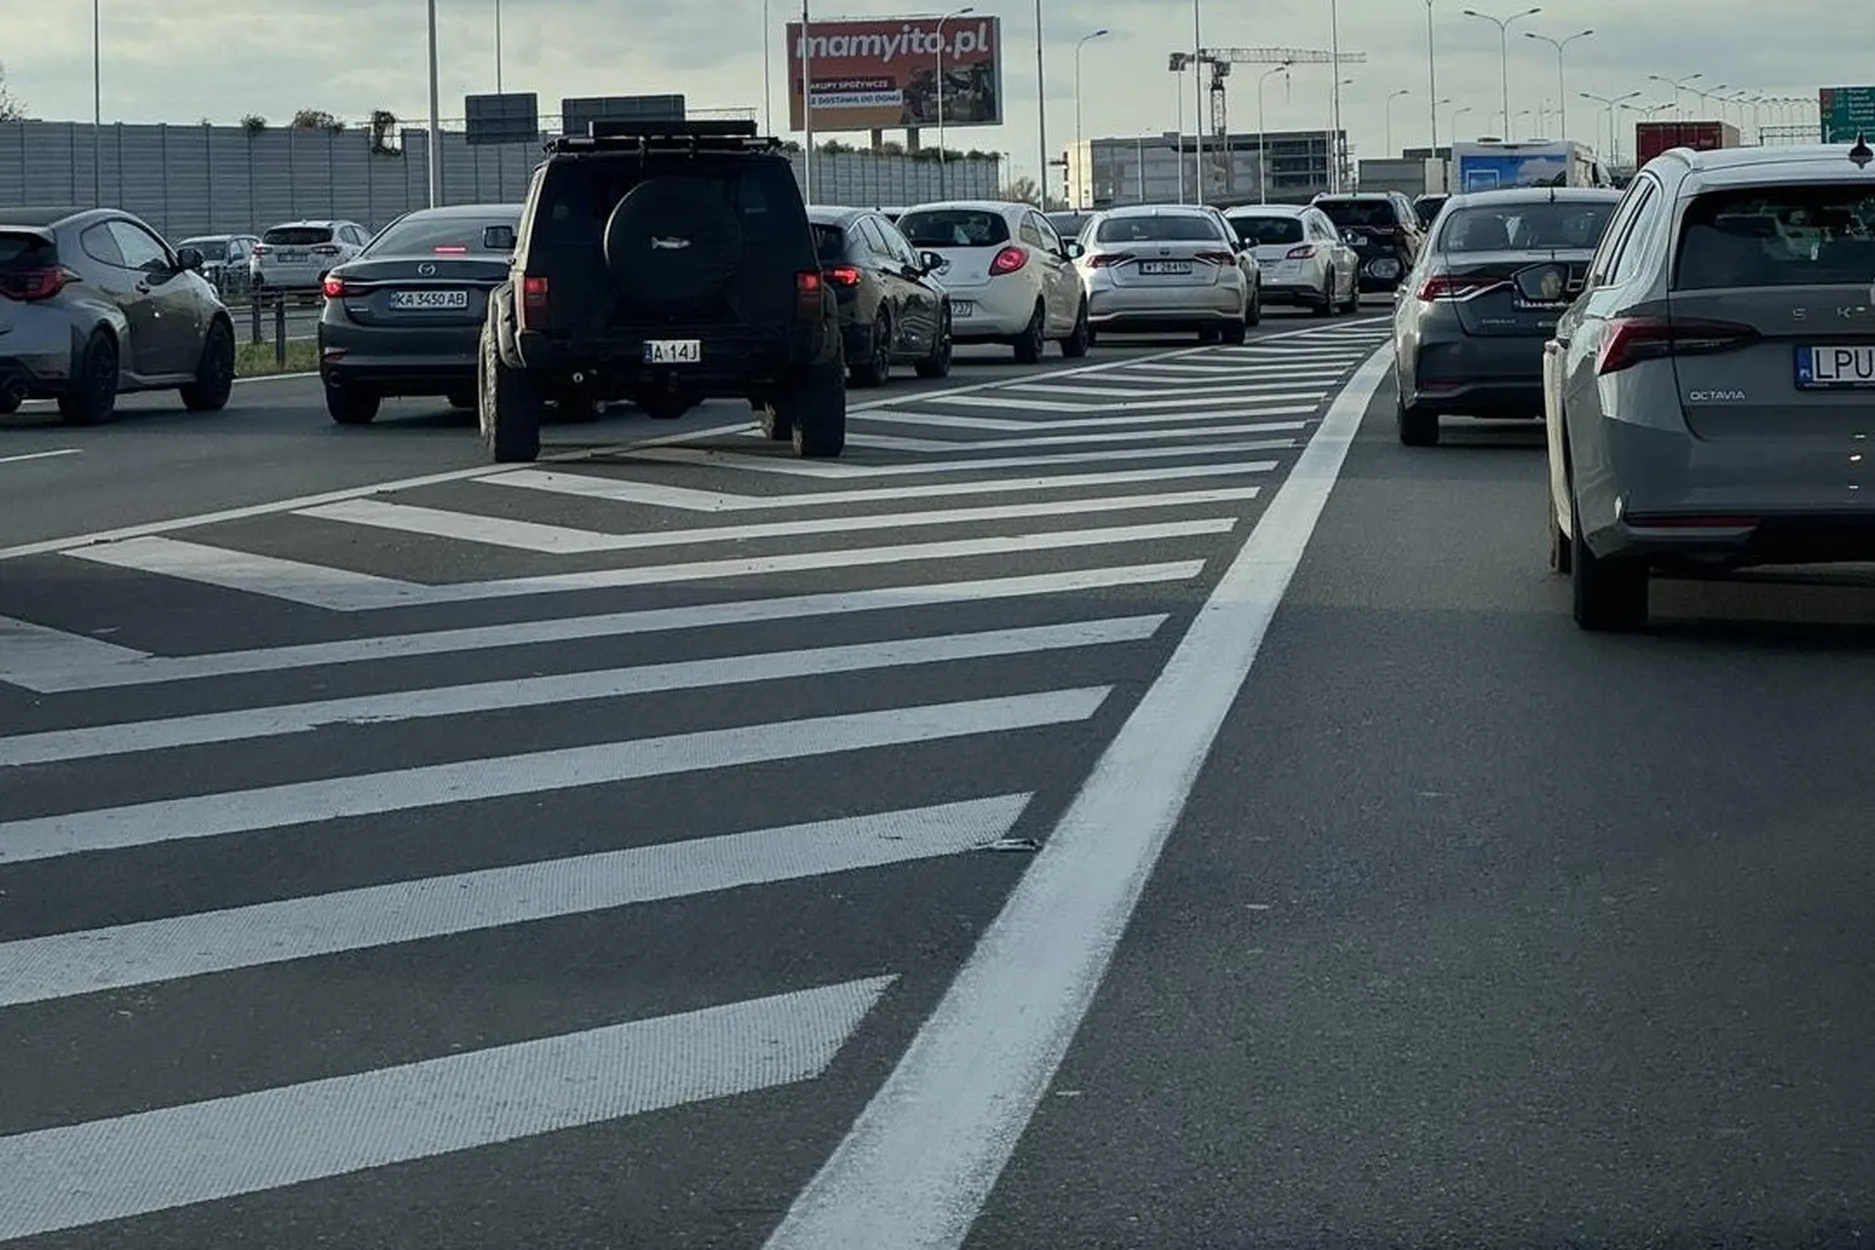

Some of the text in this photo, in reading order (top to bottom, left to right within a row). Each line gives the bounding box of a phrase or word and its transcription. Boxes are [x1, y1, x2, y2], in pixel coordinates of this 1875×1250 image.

[796, 22, 989, 63] mamyito.pl
[397, 293, 414, 306] KA
[447, 293, 465, 305] AB
[655, 345, 664, 360] A
[1815, 350, 1873, 379] LPU
[1690, 390, 1746, 401] OCTAVIA
